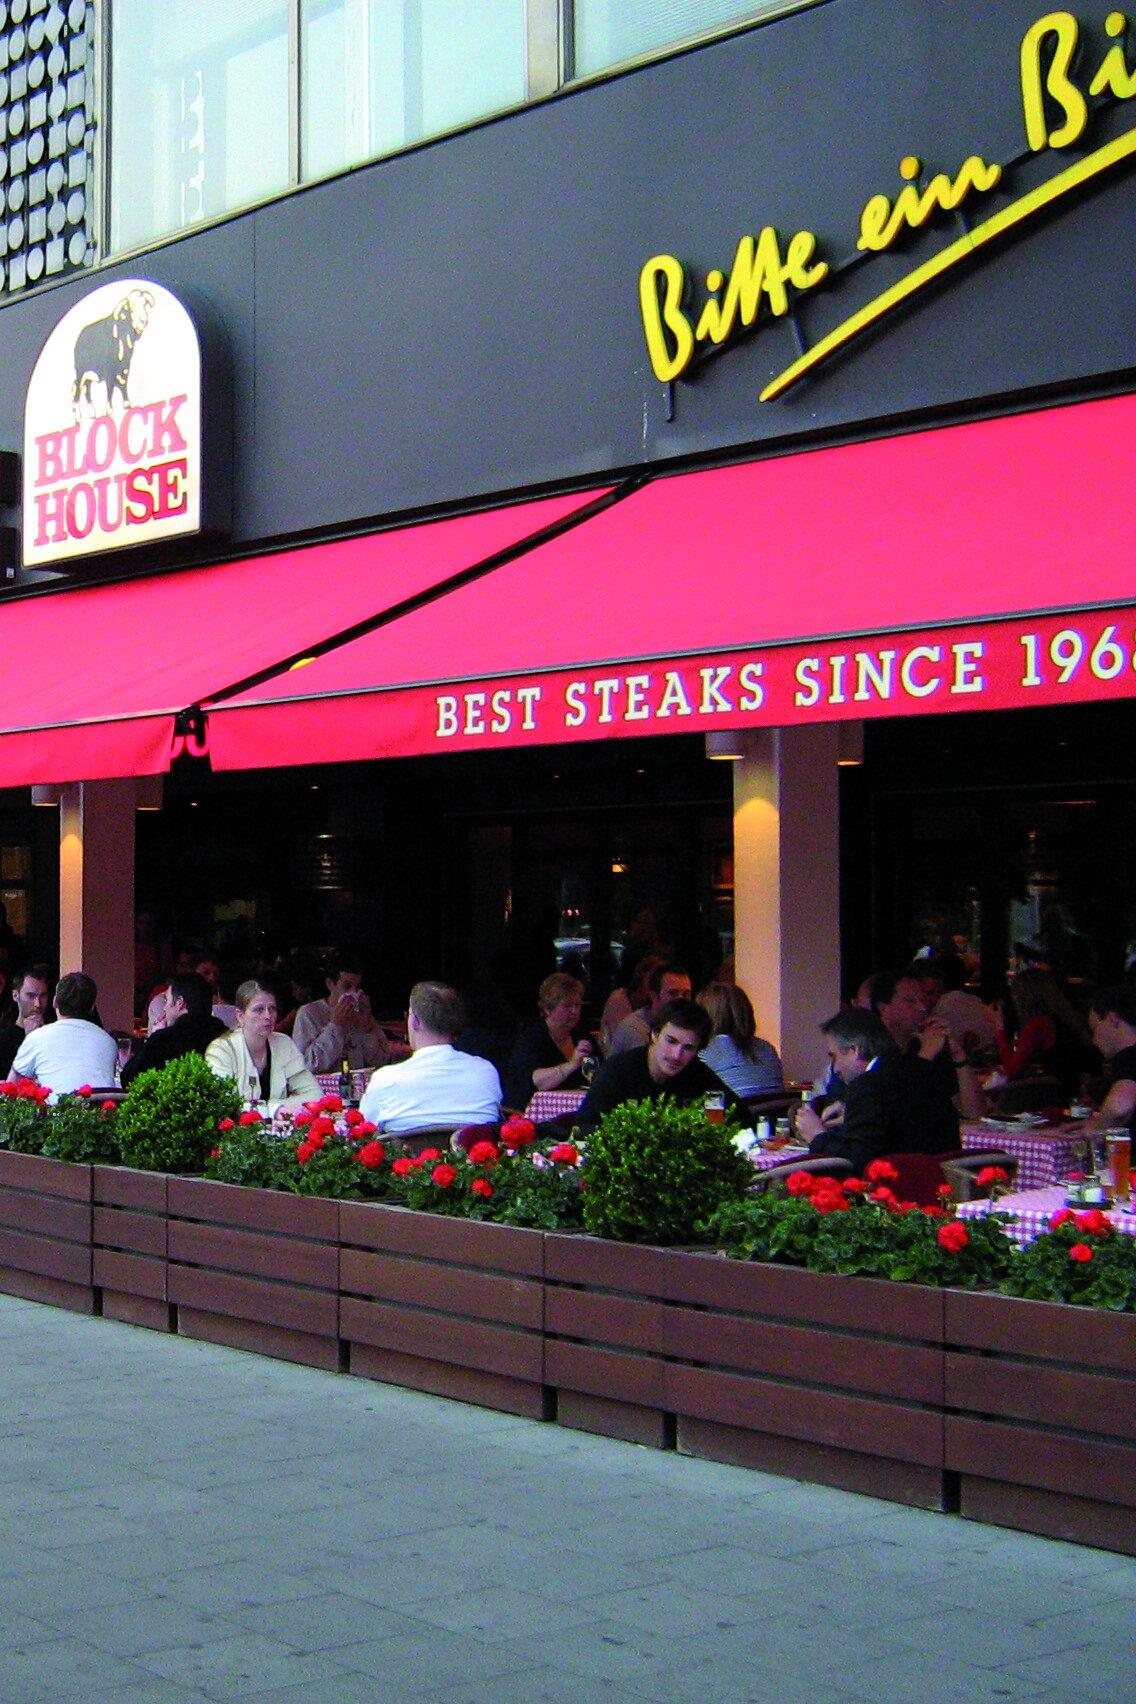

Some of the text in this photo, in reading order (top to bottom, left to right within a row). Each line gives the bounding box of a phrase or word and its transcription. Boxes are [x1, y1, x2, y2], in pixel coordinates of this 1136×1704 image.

[639, 227, 828, 382] Bitte
[858, 156, 1001, 250] ein
[33, 394, 187, 488] BLOCK
[33, 458, 187, 547] HOUSE
[435, 625, 1136, 738] BEST STEAKS SINCE 196
